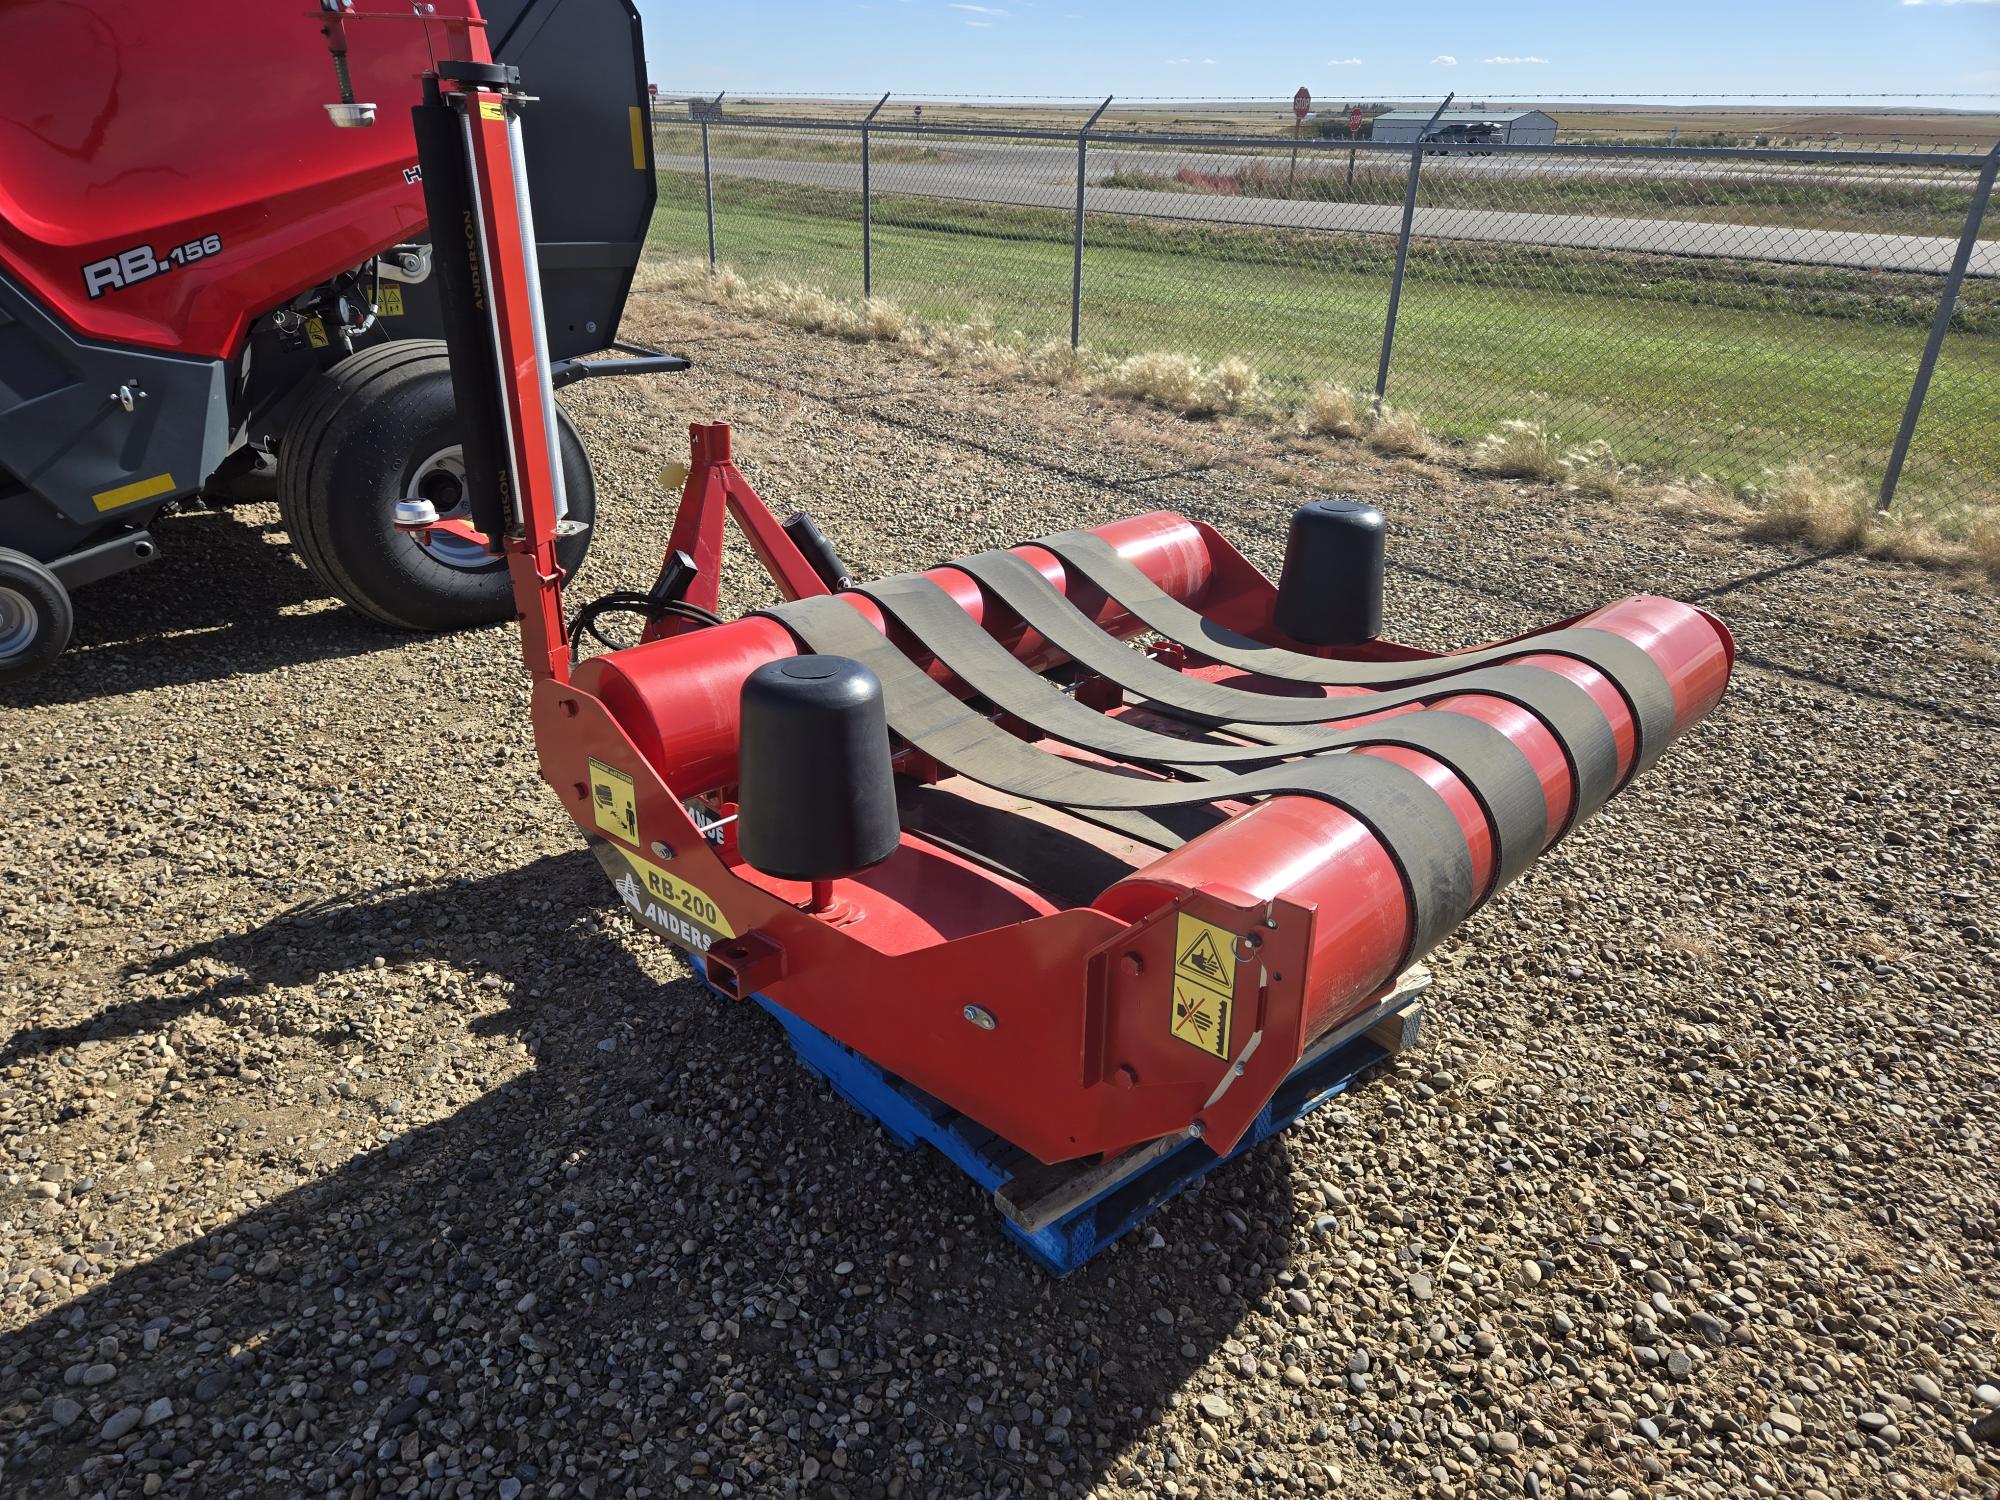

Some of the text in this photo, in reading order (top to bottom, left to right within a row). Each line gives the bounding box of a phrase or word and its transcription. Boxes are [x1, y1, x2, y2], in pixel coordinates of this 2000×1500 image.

[1294, 97, 1310, 109] STOP
[463, 210, 484, 310] ANDERSON
[647, 869, 718, 925] RB-200
